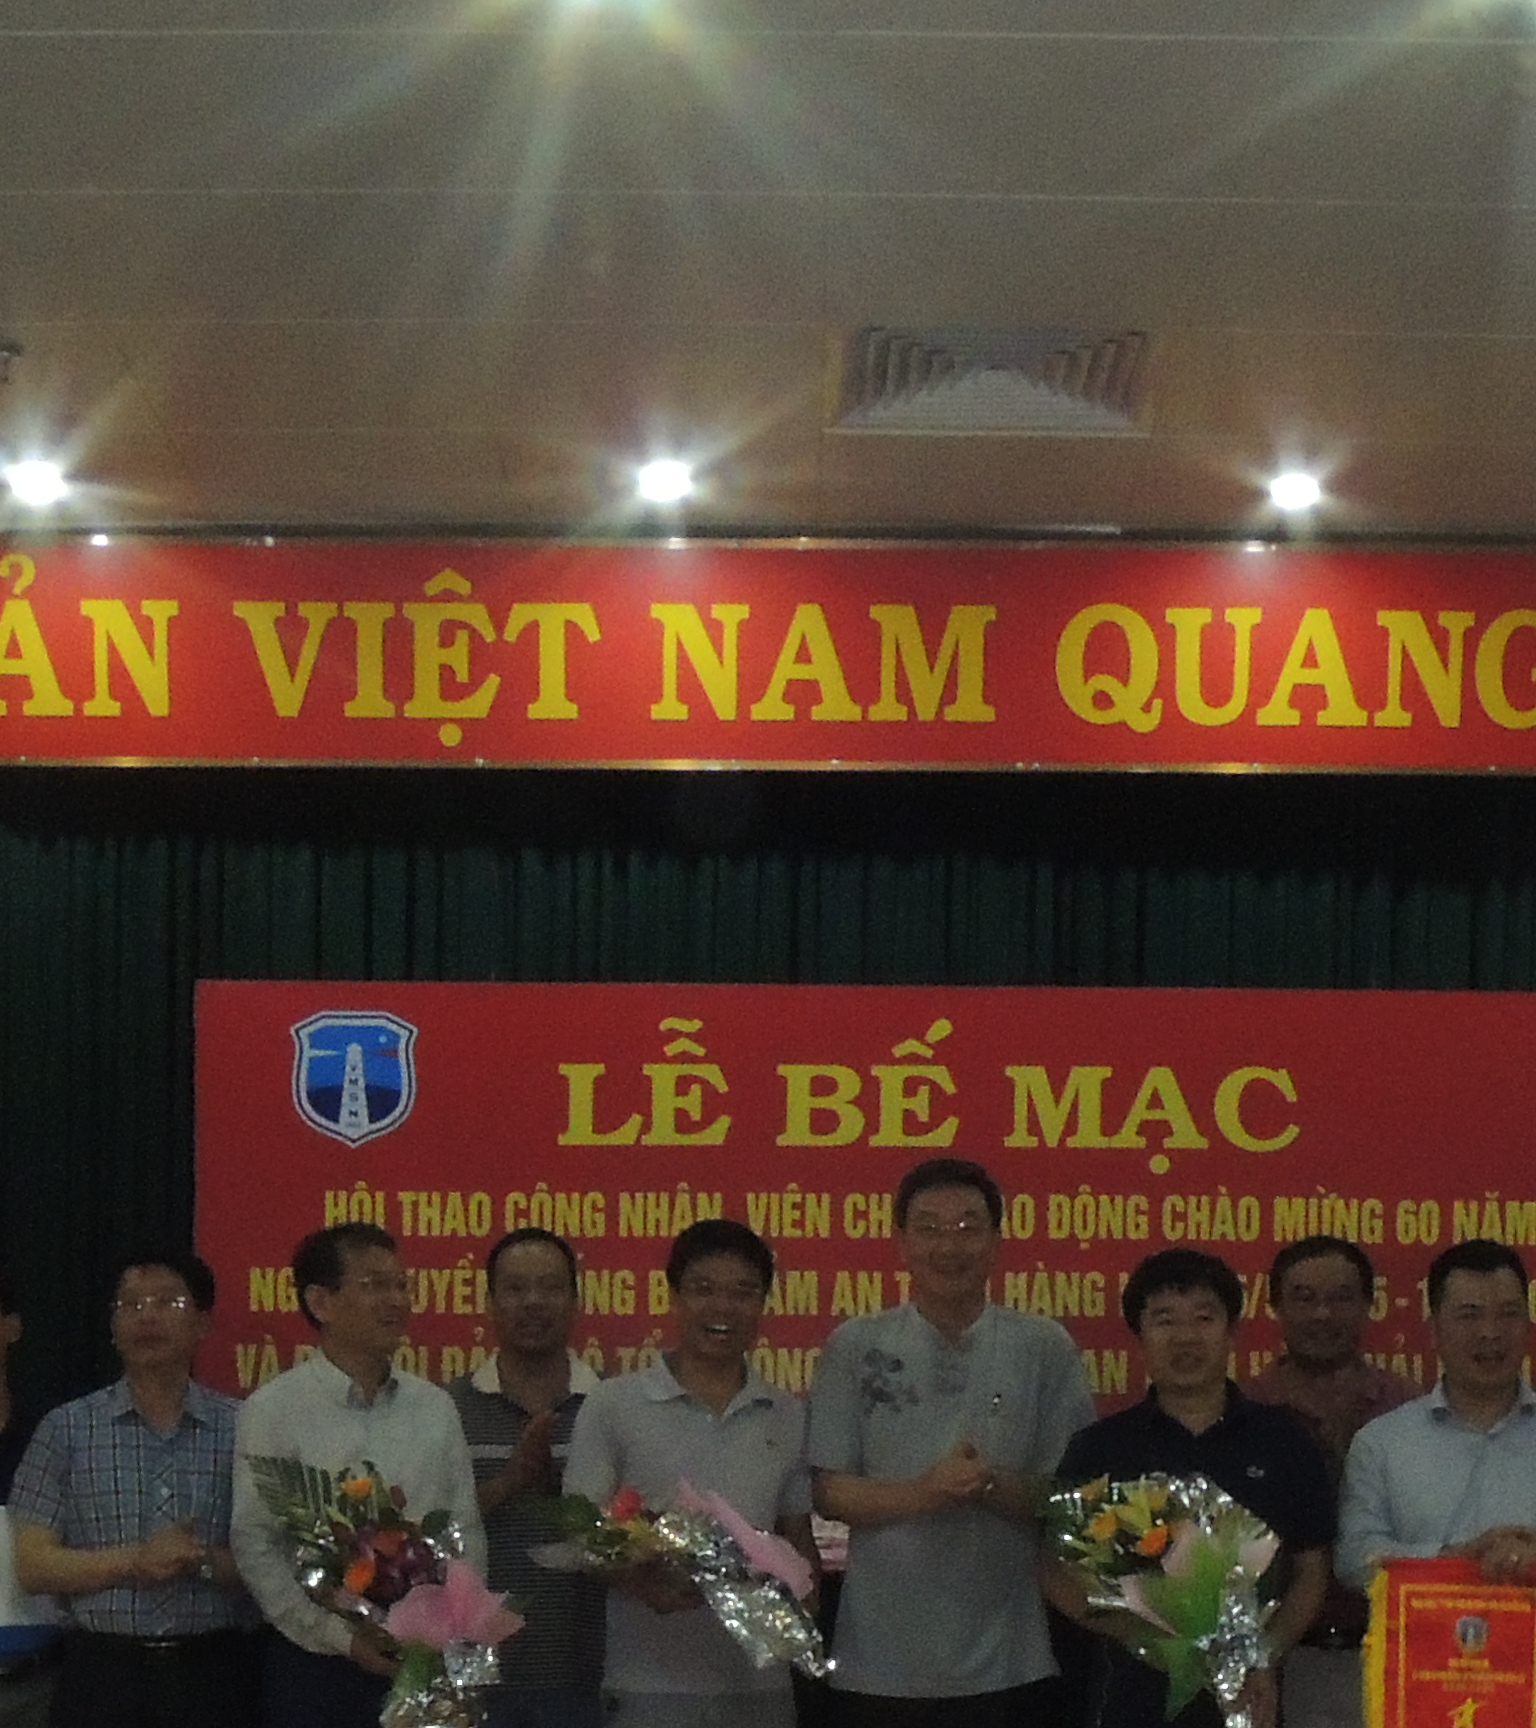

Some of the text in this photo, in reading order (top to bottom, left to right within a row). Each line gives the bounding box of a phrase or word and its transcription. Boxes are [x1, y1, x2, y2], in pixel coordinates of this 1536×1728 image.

[233, 568, 602, 747] VIỆT
[649, 601, 997, 724] NAM
[557, 1016, 1301, 1175] LỄ BẾ MẠC
[397, 1190, 493, 1238] THAO
[504, 1181, 606, 1239] CÔNG
[745, 1182, 831, 1239] VIÊN
[1047, 1183, 1150, 1250] ĐỘNG
[1161, 1185, 1260, 1242] CHÀO
[1273, 1184, 1384, 1244] MỪNG
[1395, 1200, 1439, 1245] 60
[831, 1270, 884, 1317] AN
[1004, 1261, 1106, 1318] HÀNG
